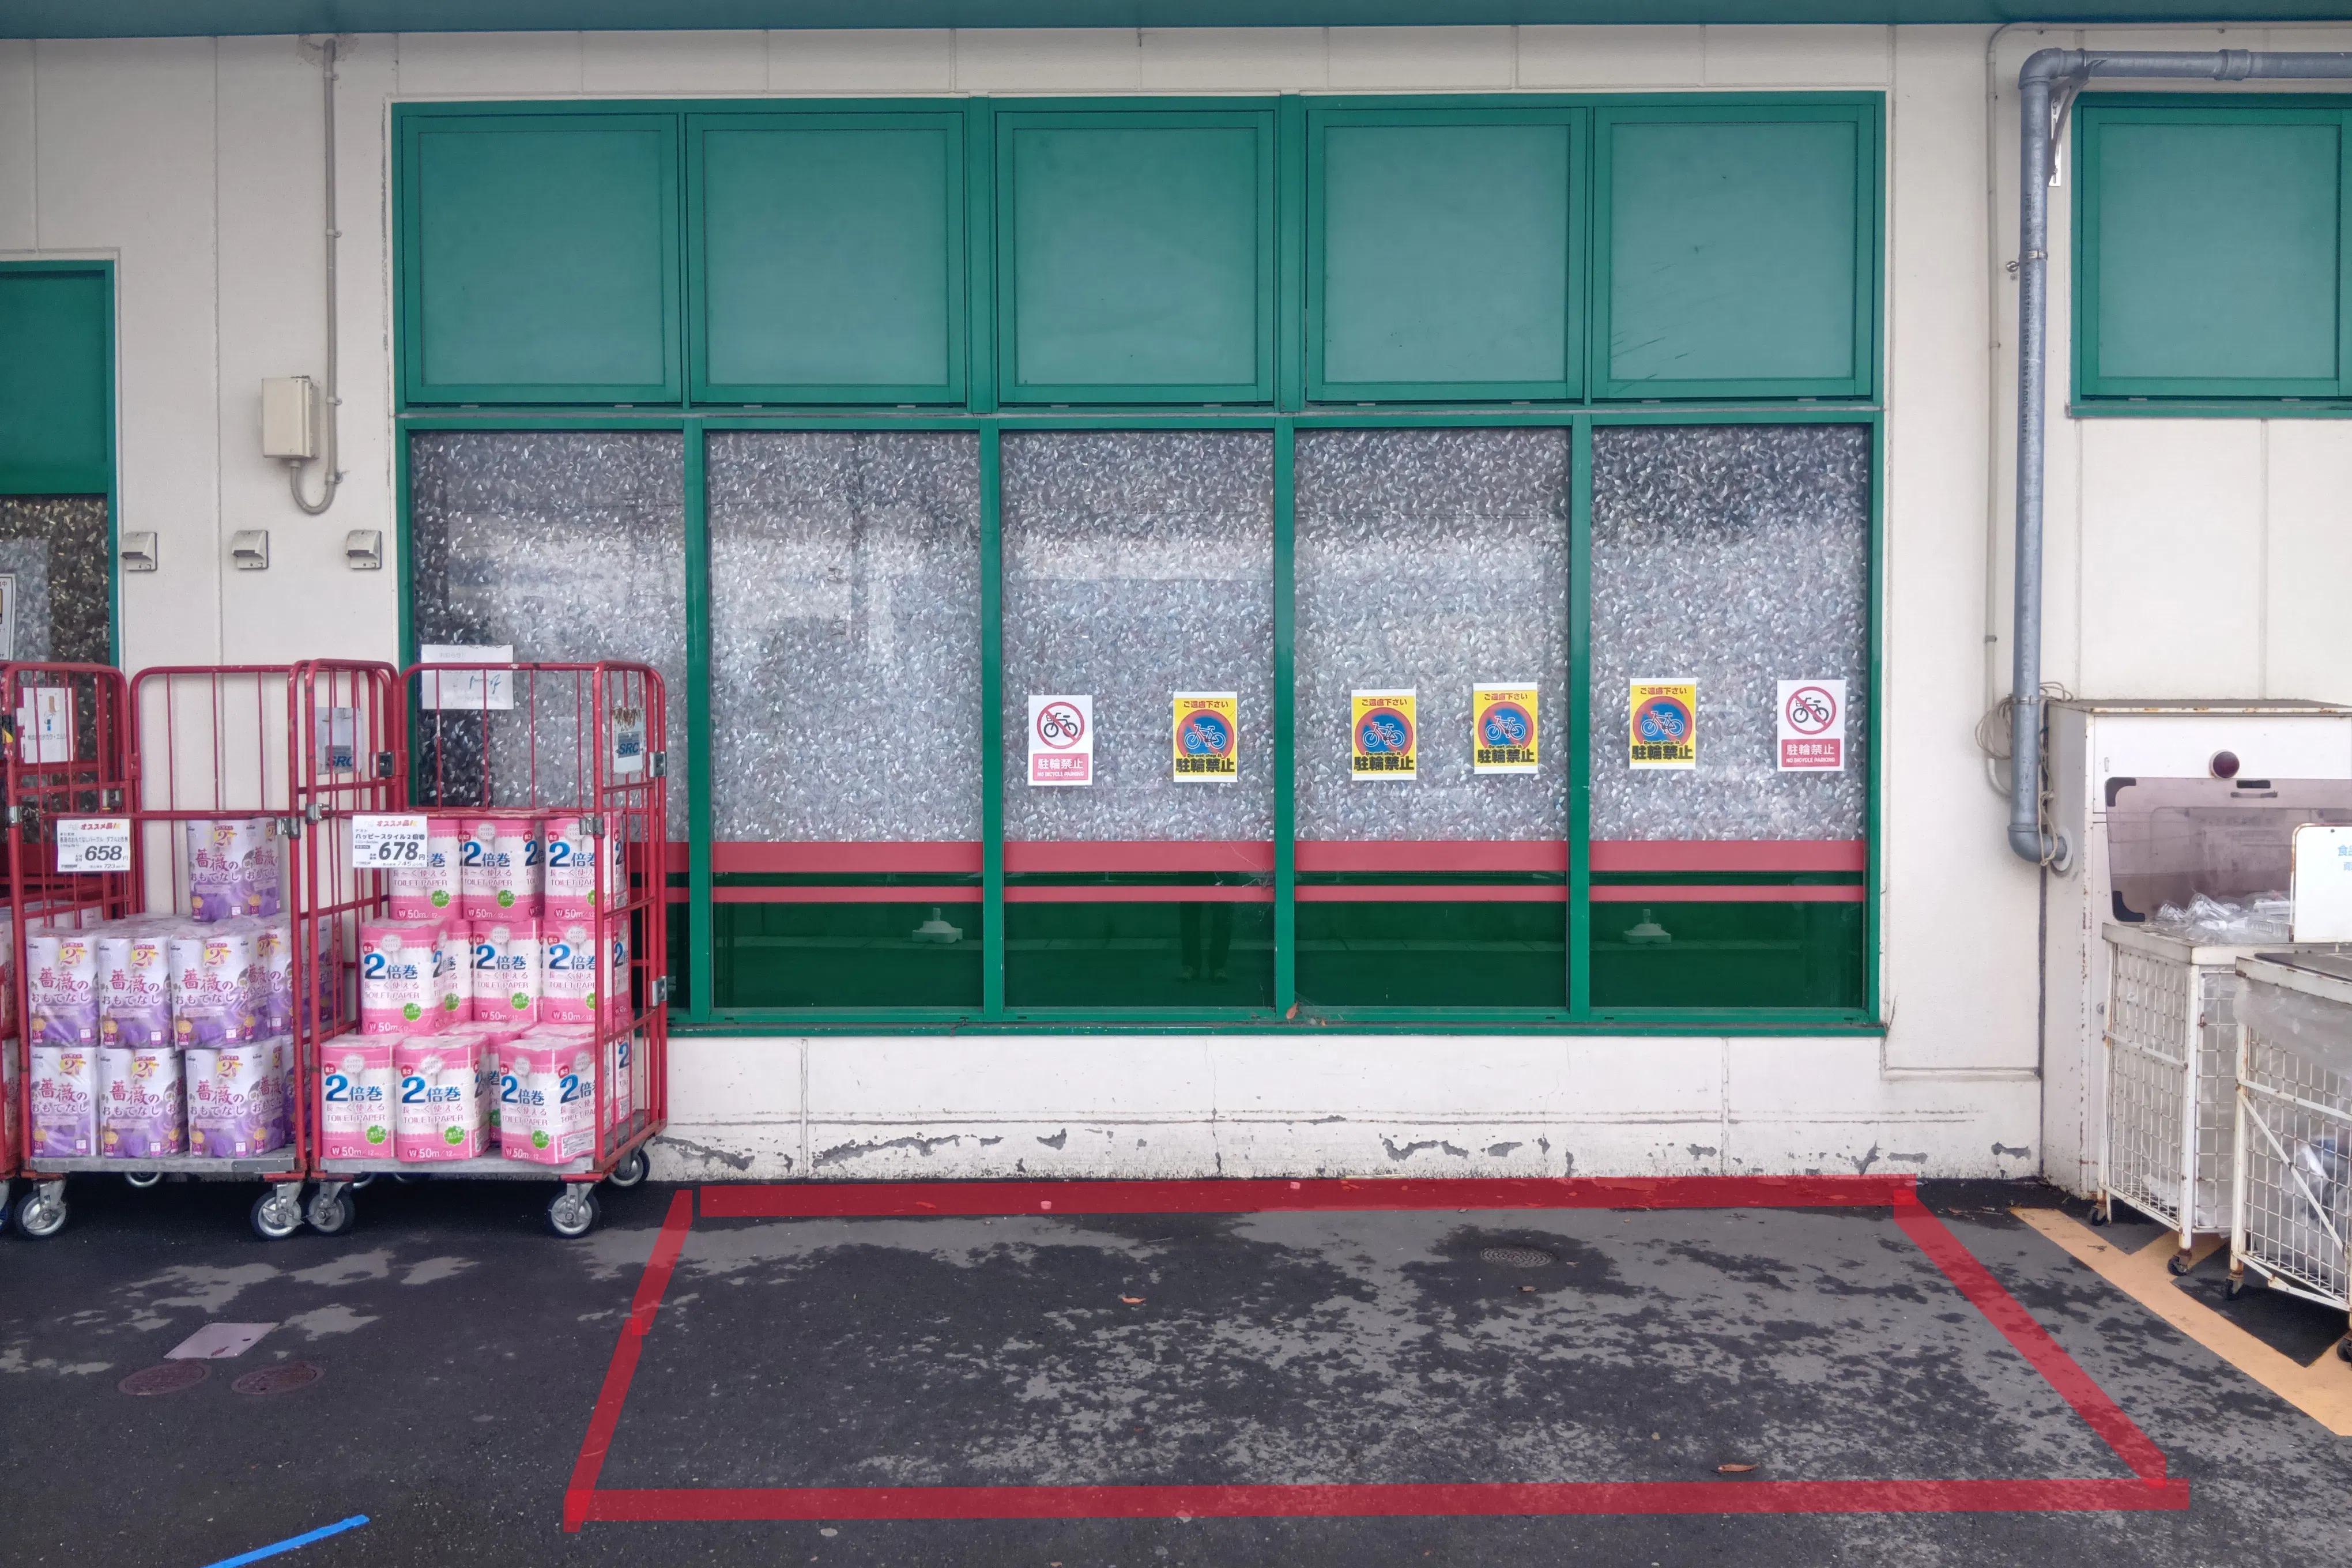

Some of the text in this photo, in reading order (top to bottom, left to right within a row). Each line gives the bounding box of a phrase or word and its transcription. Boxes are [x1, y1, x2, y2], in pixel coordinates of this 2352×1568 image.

[619, 742, 639, 755] SRC
[1631, 745, 1693, 760] 駐輪禁止
[1787, 744, 1834, 755] 駐輪禁止
[1477, 749, 1535, 763] 駐輪禁止
[1038, 758, 1083, 769] 駐輪禁止
[1175, 758, 1235, 772] 駐輪禁止
[1354, 756, 1414, 771] 駐輪禁止
[85, 846, 122, 861] 658
[379, 842, 419, 860] 678
[195, 848, 239, 871] 薔薇の
[191, 872, 239, 881] おもてなし
[39, 967, 89, 992] 薔薇の
[110, 969, 160, 994] 薔薇の
[182, 968, 233, 993] 薔薇の
[31, 993, 90, 1003] おもてなし
[102, 995, 161, 1005] おもてなし
[175, 994, 234, 1005] おもてなし
[39, 1078, 87, 1102] 薔薇の
[110, 1080, 160, 1105] 薔薇の
[196, 1079, 244, 1105] 薔薇の
[560, 1075, 595, 1104] 2倍
[32, 1103, 88, 1113] おもてなし
[102, 1106, 161, 1116] おもてなし
[190, 1106, 245, 1117] おもてなし
[503, 1116, 547, 1125] TOILET PAPER
[561, 1113, 583, 1123] TOILET
